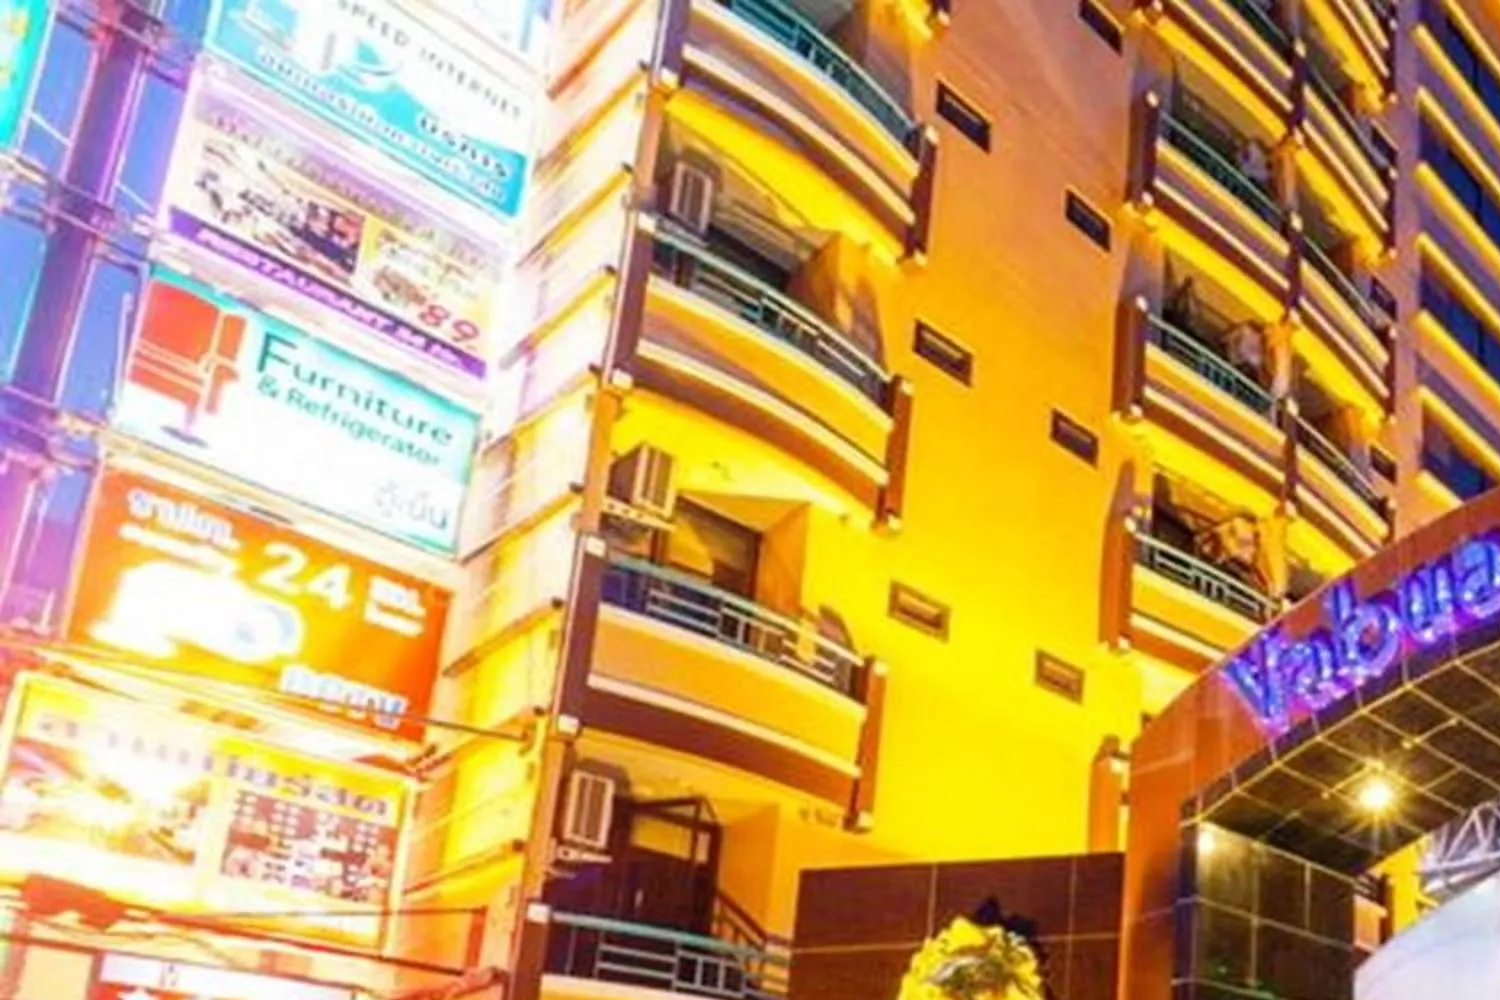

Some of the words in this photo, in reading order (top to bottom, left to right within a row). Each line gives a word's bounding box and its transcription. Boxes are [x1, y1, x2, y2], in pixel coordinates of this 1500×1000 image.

[338, 0, 411, 47] SPEED
[418, 46, 522, 119] INTERNET
[256, 332, 454, 446] Furniture
[257, 373, 280, 400] &
[286, 386, 441, 466] Refrigerator
[256, 540, 354, 612] 24
